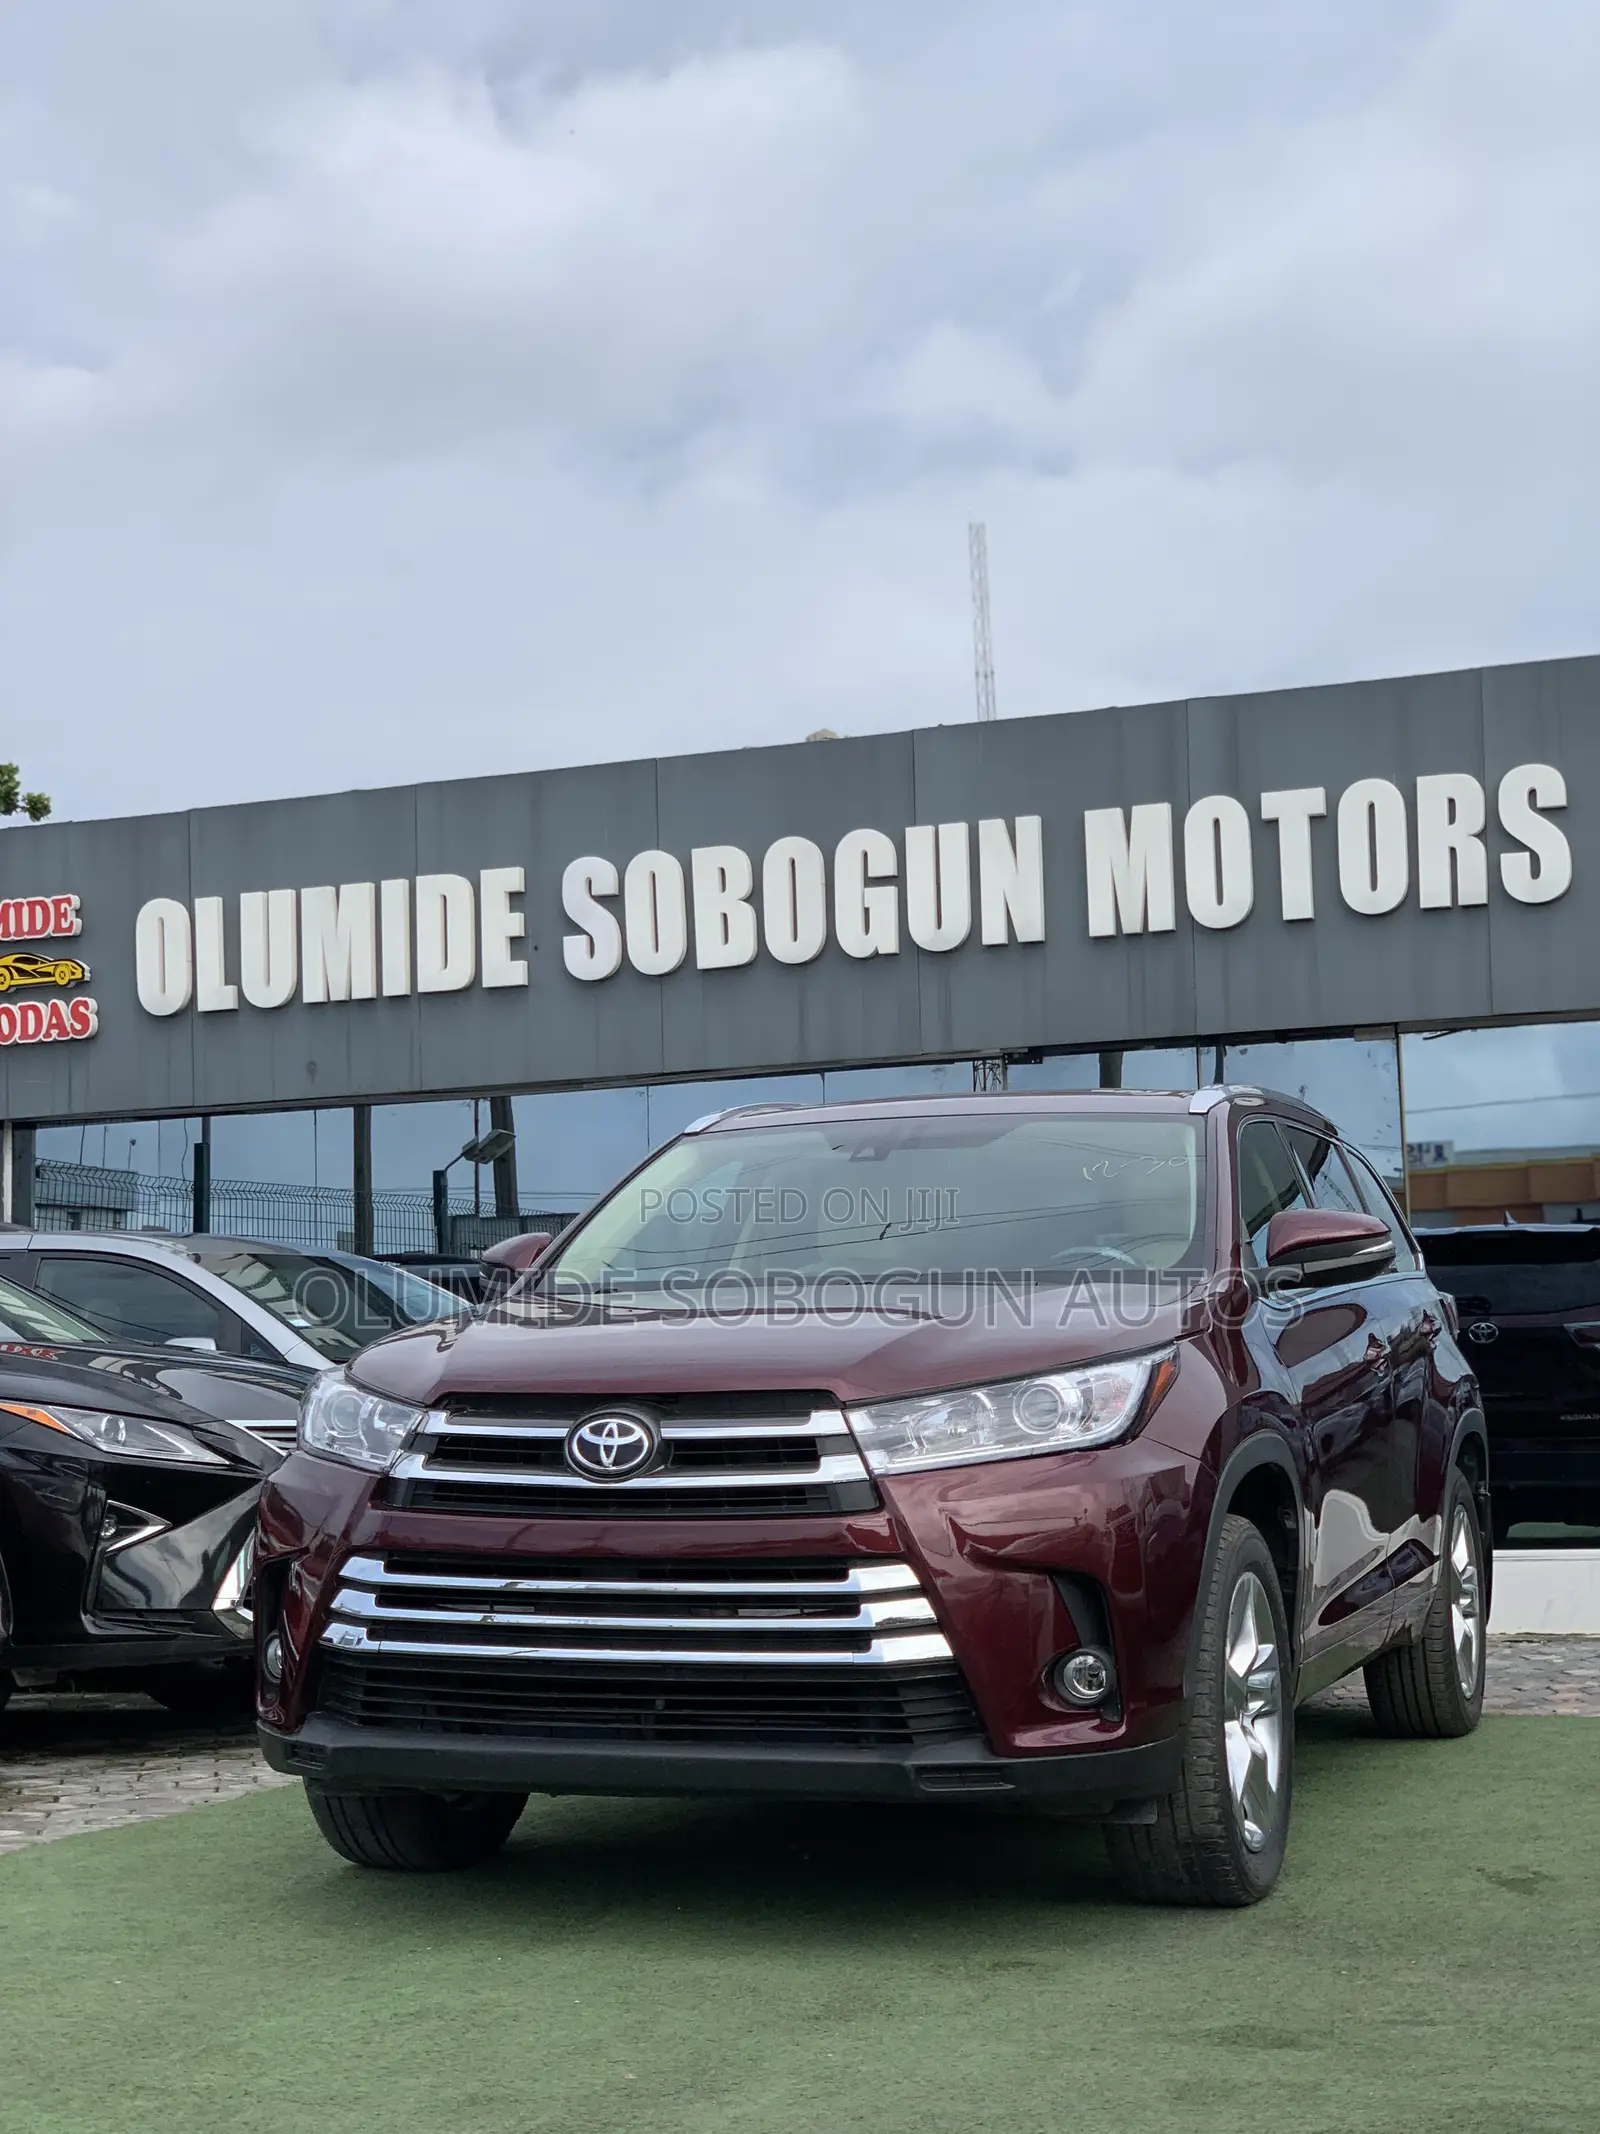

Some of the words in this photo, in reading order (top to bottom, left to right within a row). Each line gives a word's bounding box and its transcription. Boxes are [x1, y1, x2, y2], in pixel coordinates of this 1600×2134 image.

[135, 866, 529, 1017] OLUMIDE
[562, 815, 1046, 981] SOBOGUN
[1084, 763, 1573, 938] MOTORS
